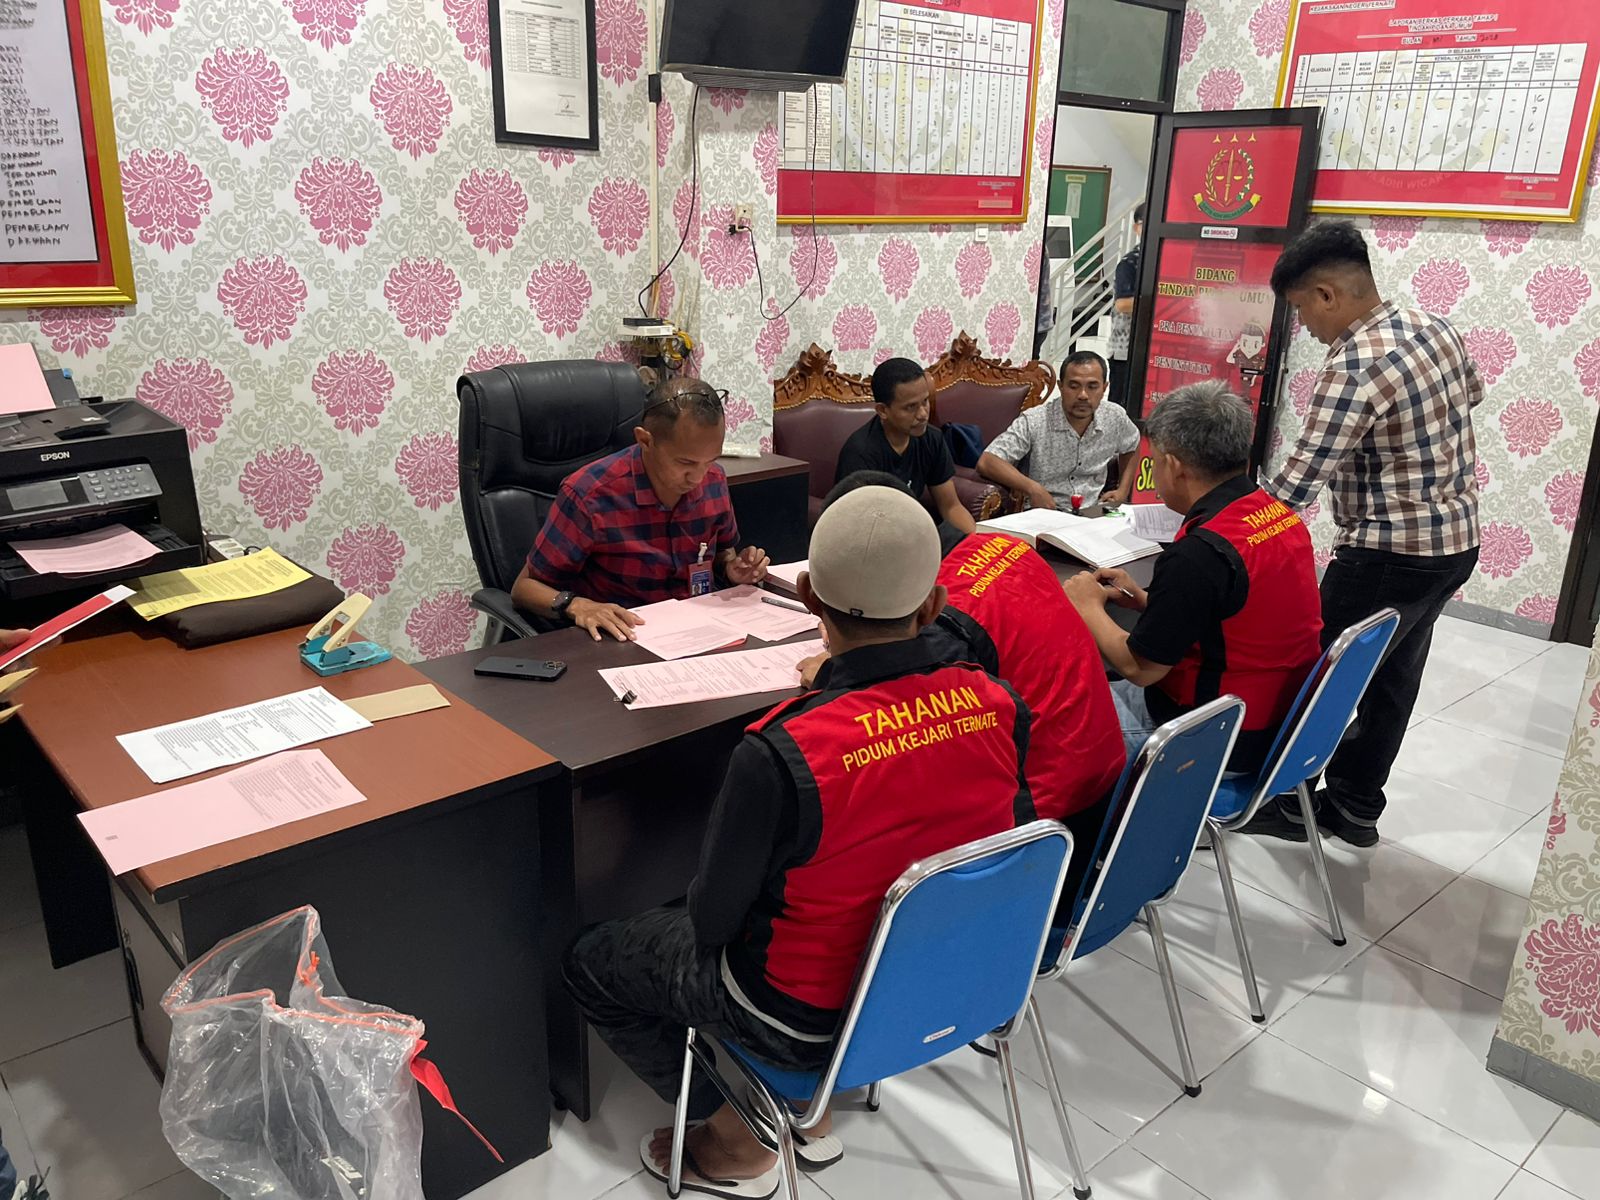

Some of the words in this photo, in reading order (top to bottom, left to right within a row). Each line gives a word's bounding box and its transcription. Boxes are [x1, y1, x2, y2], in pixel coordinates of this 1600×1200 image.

[1196, 267, 1236, 281] BIDANG
[1158, 282, 1196, 297] TINDAK
[40, 451, 70, 462] EPSON
[1241, 500, 1290, 529] TAHANAN
[956, 536, 1013, 577] TAHANAN
[854, 686, 984, 738] TAHANAN
[842, 738, 897, 773] PIDUM
[897, 722, 953, 753] KEJARI
[953, 711, 999, 736] TERNATE
